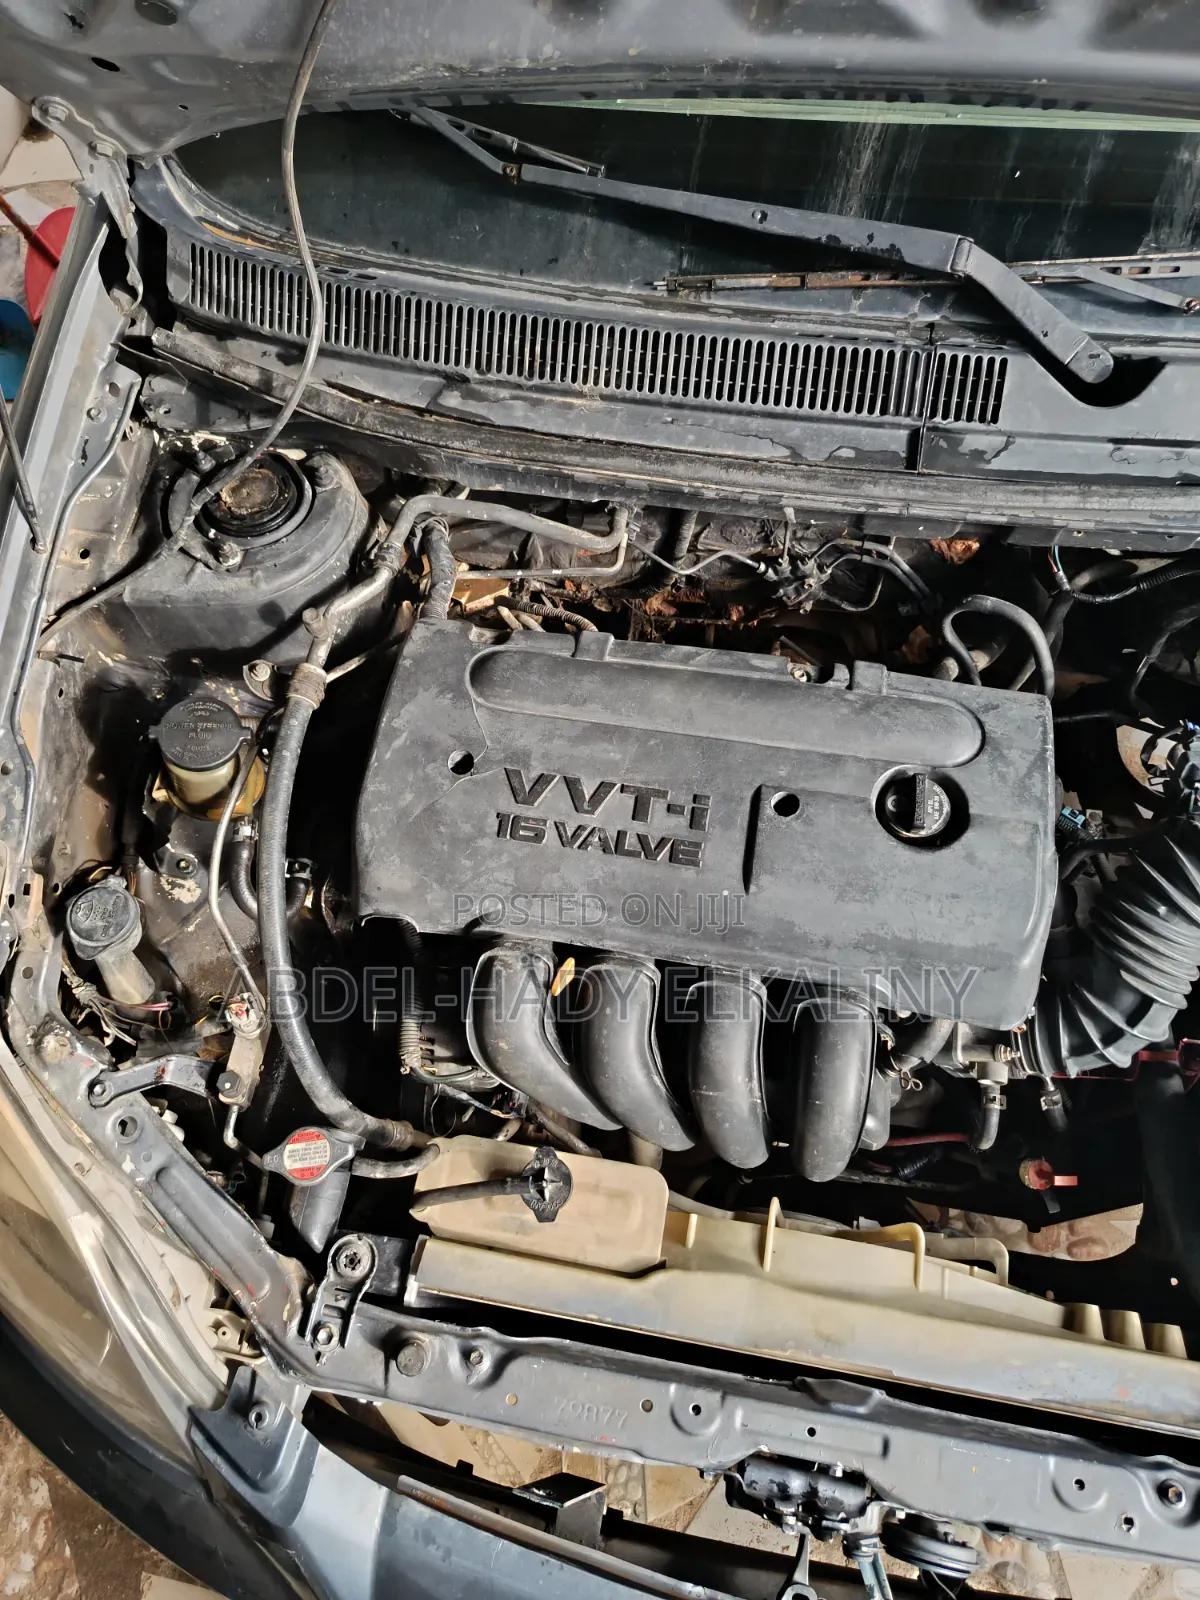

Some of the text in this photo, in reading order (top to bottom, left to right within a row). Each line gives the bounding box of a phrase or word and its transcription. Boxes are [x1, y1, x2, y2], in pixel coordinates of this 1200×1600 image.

[166, 722, 195, 730] POWER
[188, 732, 212, 740] FLUID
[503, 767, 712, 831] VVT-i
[496, 812, 704, 867] 16 VALVE
